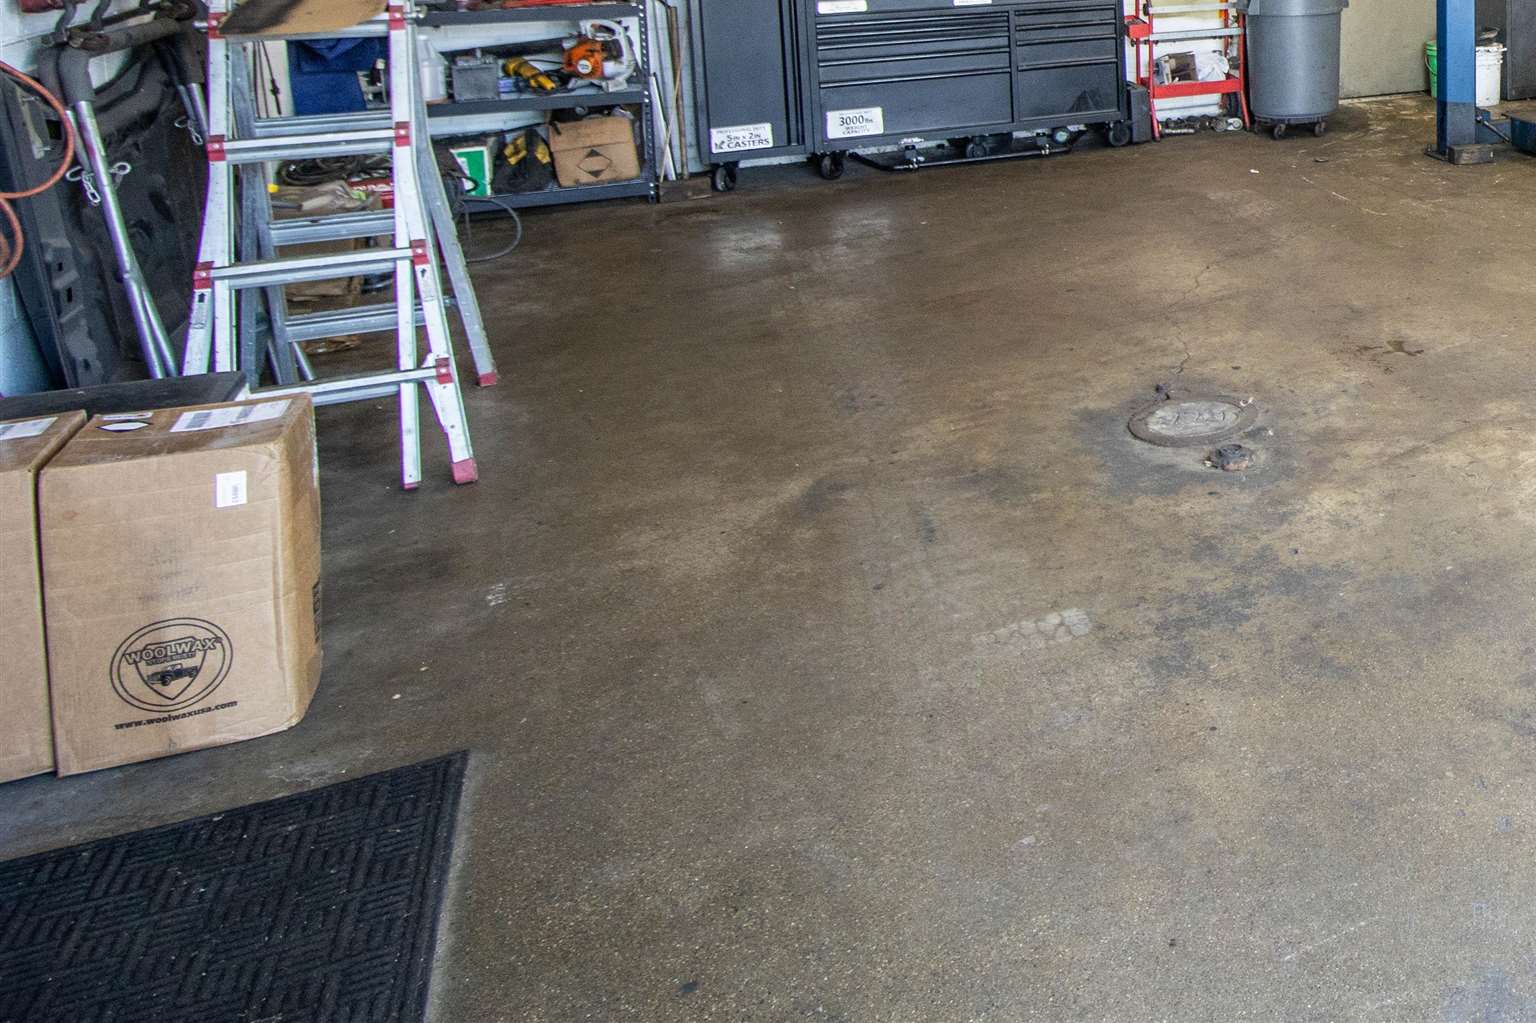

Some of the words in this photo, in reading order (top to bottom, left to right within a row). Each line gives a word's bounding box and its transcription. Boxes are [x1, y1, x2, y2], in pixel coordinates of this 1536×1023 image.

[839, 114, 864, 127] 3000
[727, 138, 770, 149] CASTERS
[123, 637, 217, 665] WOOLWAX
[114, 700, 238, 730] www.woolwaxusa.com
